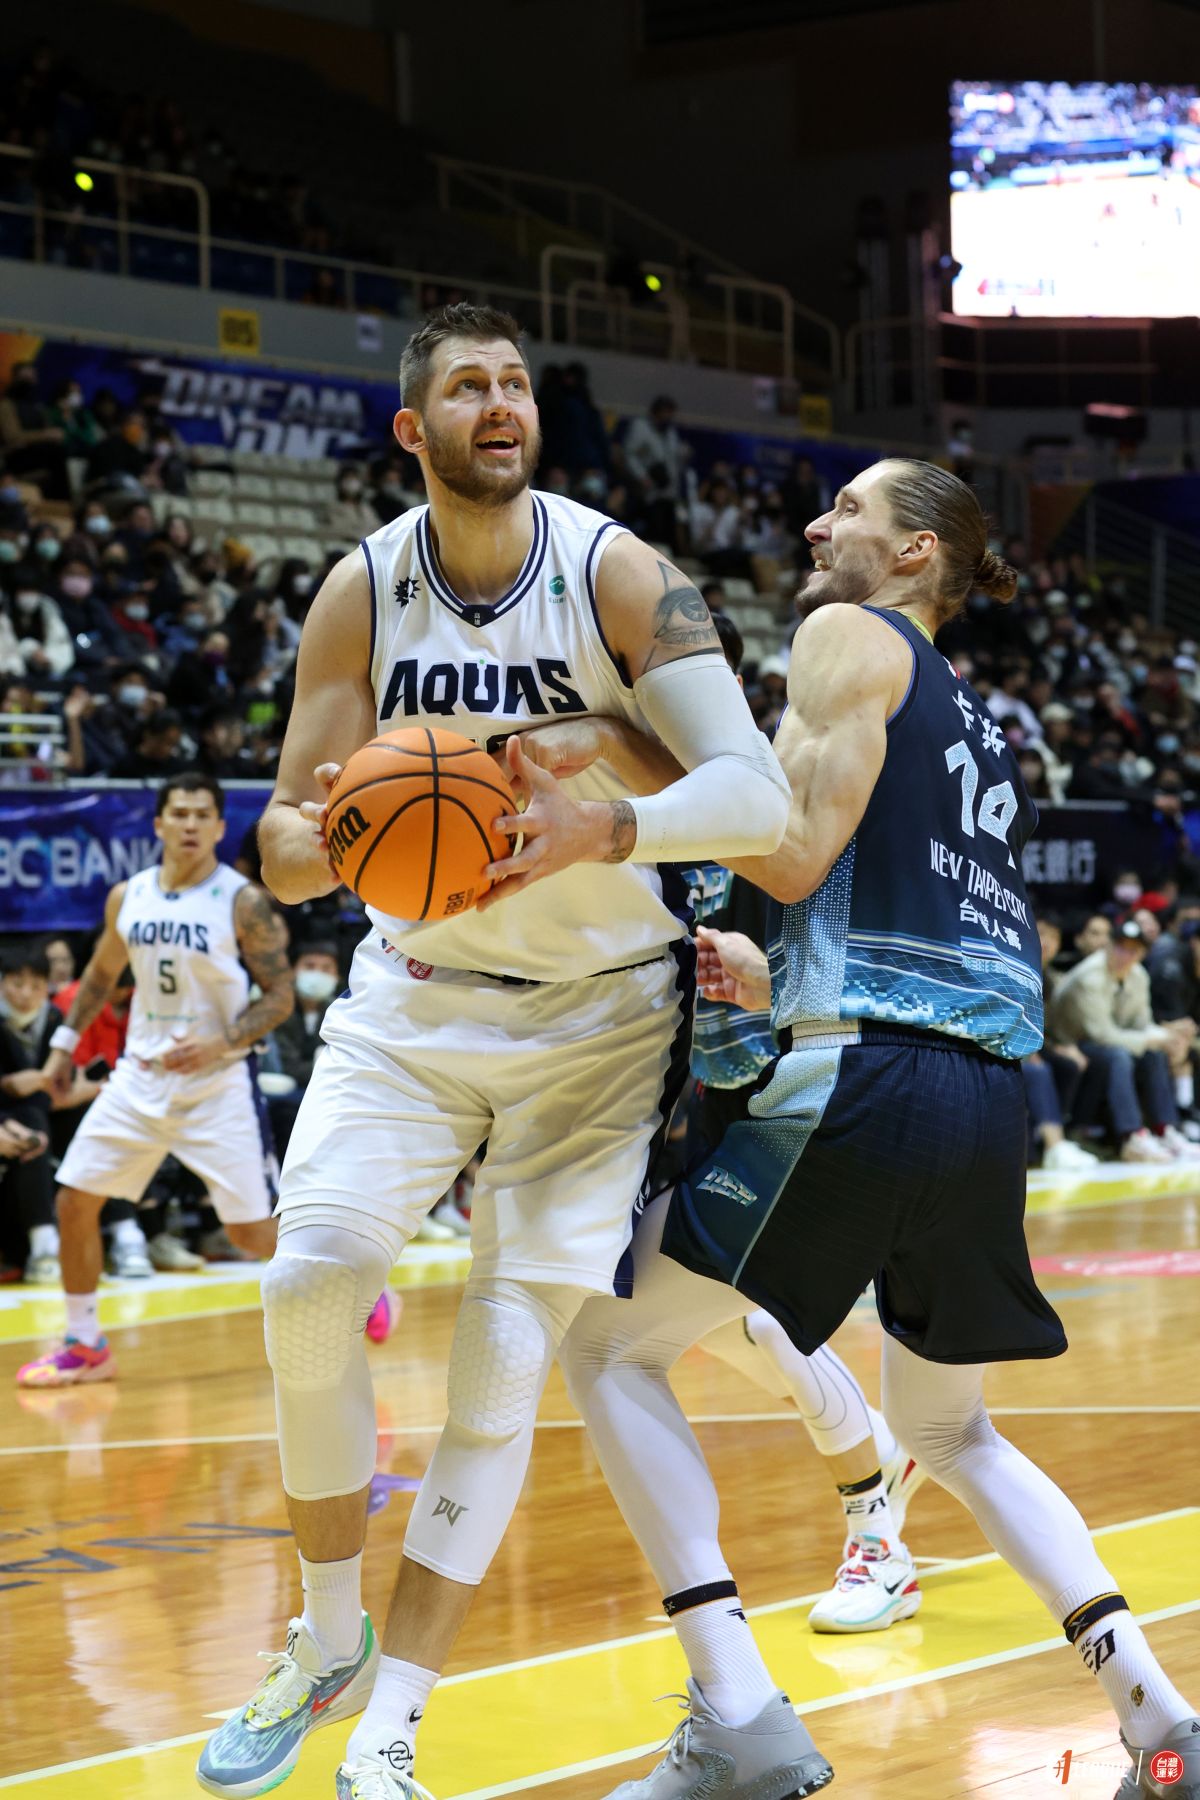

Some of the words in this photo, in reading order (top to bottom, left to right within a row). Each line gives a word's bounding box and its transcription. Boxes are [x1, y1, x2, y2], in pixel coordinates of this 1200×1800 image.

[160, 367, 365, 430] DREAM
[379, 657, 588, 721] AQUAS
[52, 836, 161, 890] BANK
[328, 805, 372, 867] Wil
[129, 921, 208, 954] AQUAS
[159, 960, 176, 993] 5
